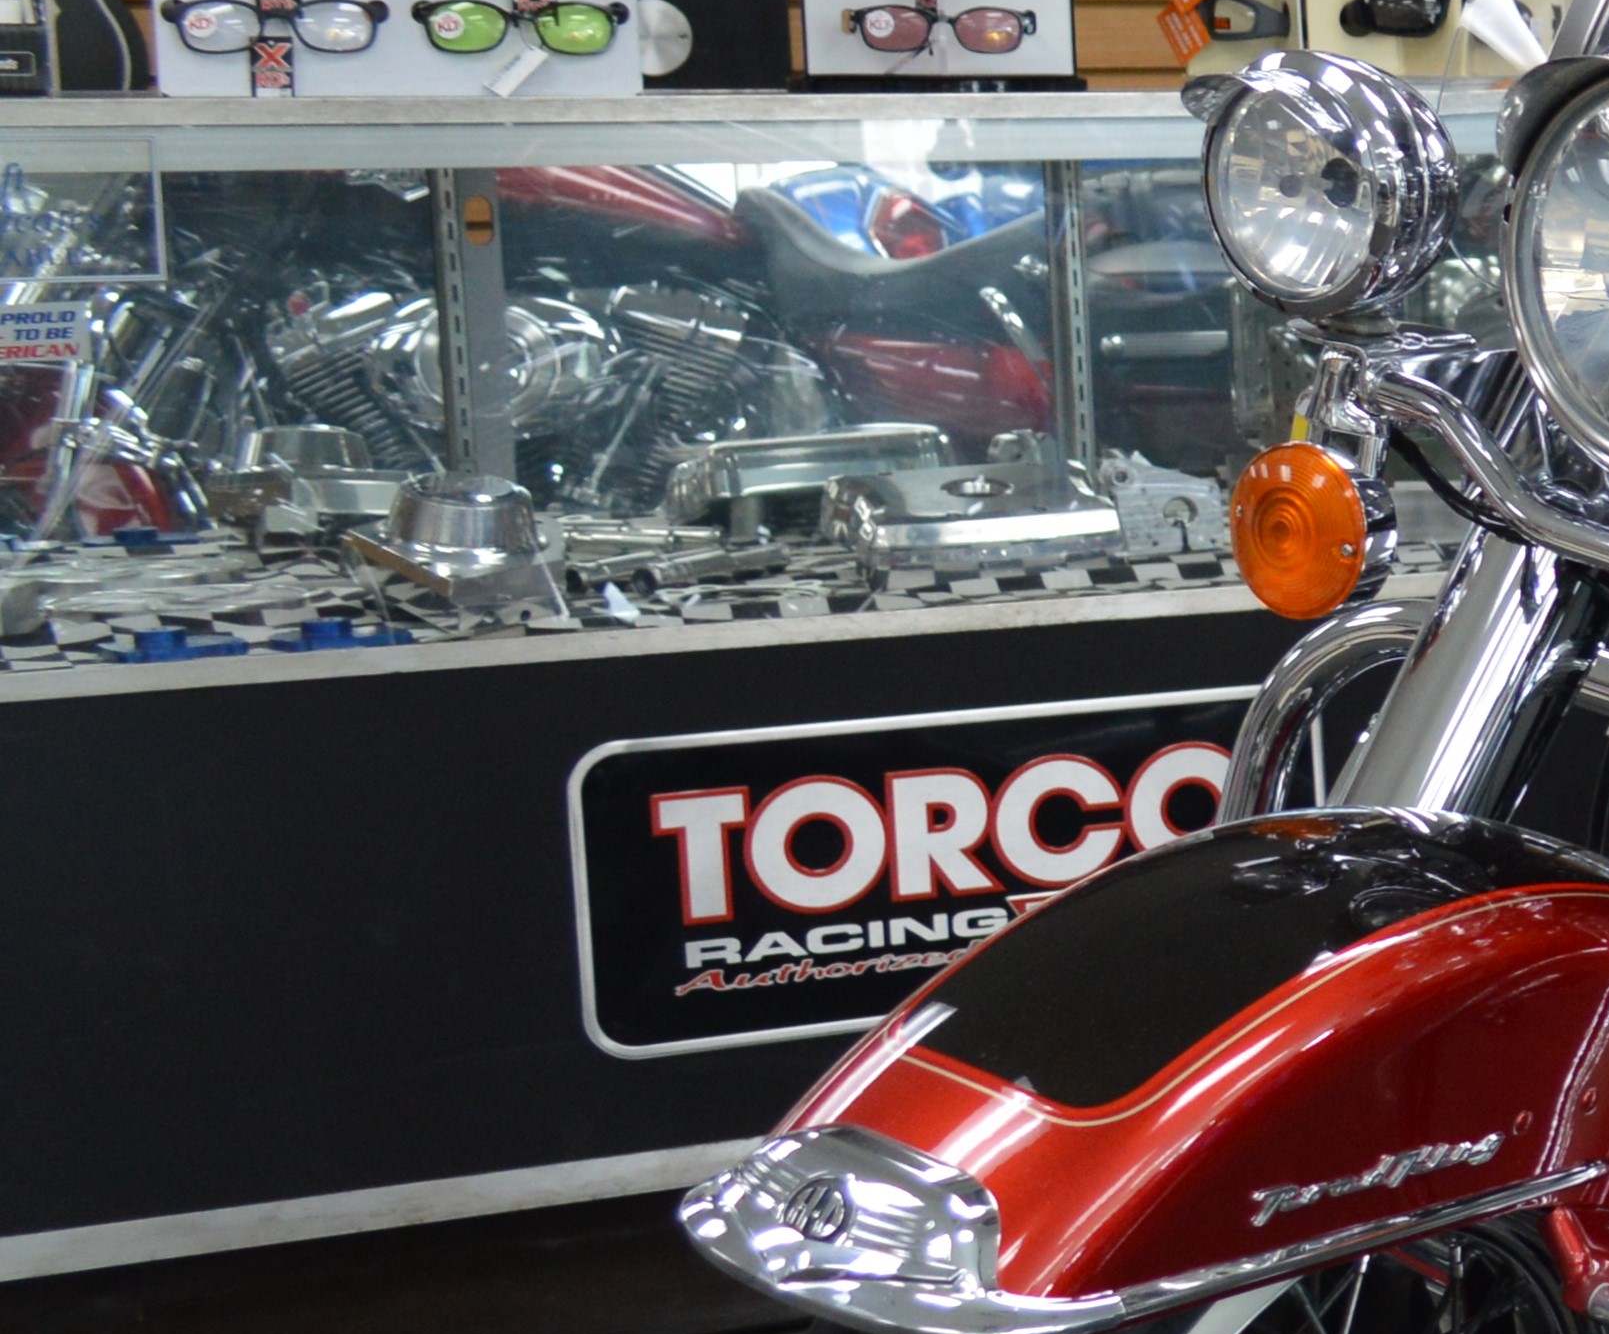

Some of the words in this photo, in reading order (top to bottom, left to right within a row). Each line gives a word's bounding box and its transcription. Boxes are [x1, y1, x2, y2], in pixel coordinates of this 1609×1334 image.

[0, 309, 77, 326] PROUD
[13, 327, 40, 342] TO
[45, 326, 75, 340] BE
[650, 740, 1236, 927] TORCO
[683, 906, 1012, 969] RACING
